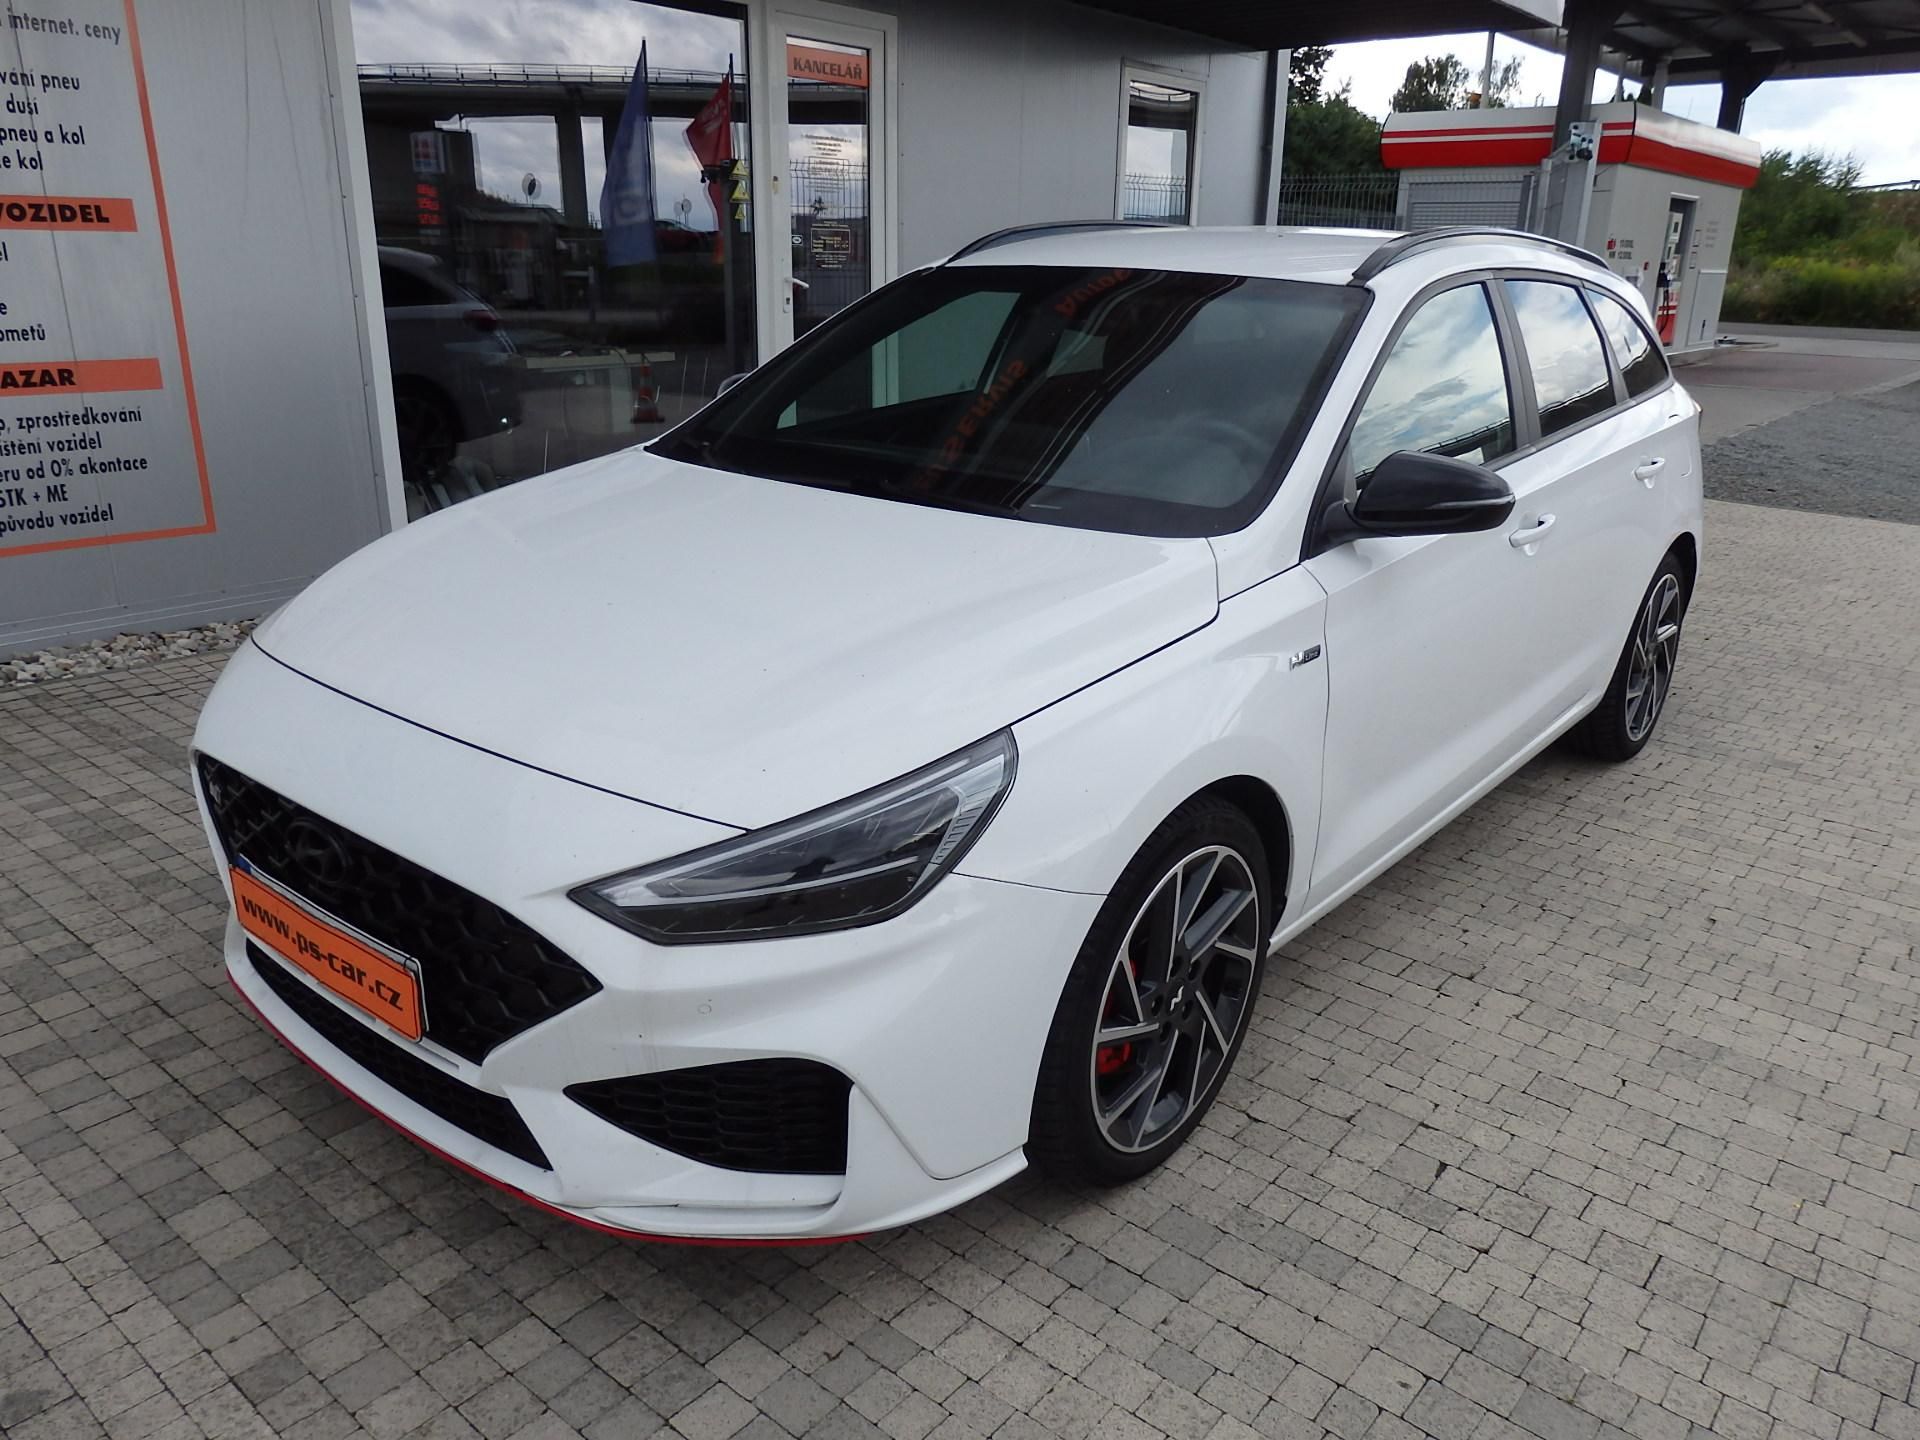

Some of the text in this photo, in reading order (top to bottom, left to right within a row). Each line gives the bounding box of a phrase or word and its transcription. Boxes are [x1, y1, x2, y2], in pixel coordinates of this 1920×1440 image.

[84, 22, 121, 46] ceny
[793, 57, 863, 81] KANCELÁŘ
[40, 73, 81, 93] pneu
[44, 130, 54, 144] a
[58, 123, 86, 146] kol
[16, 148, 44, 171] kol
[0, 368, 78, 389] AZAR
[16, 405, 143, 434] zprostředkování
[46, 431, 103, 454] vozidel
[26, 459, 46, 480] od
[50, 458, 74, 477] 0%
[79, 456, 149, 475] akontace
[33, 491, 41, 502] +
[46, 483, 69, 503] ME
[59, 503, 114, 526] vozidel
[240, 894, 404, 1013] www.ps-car.cz
